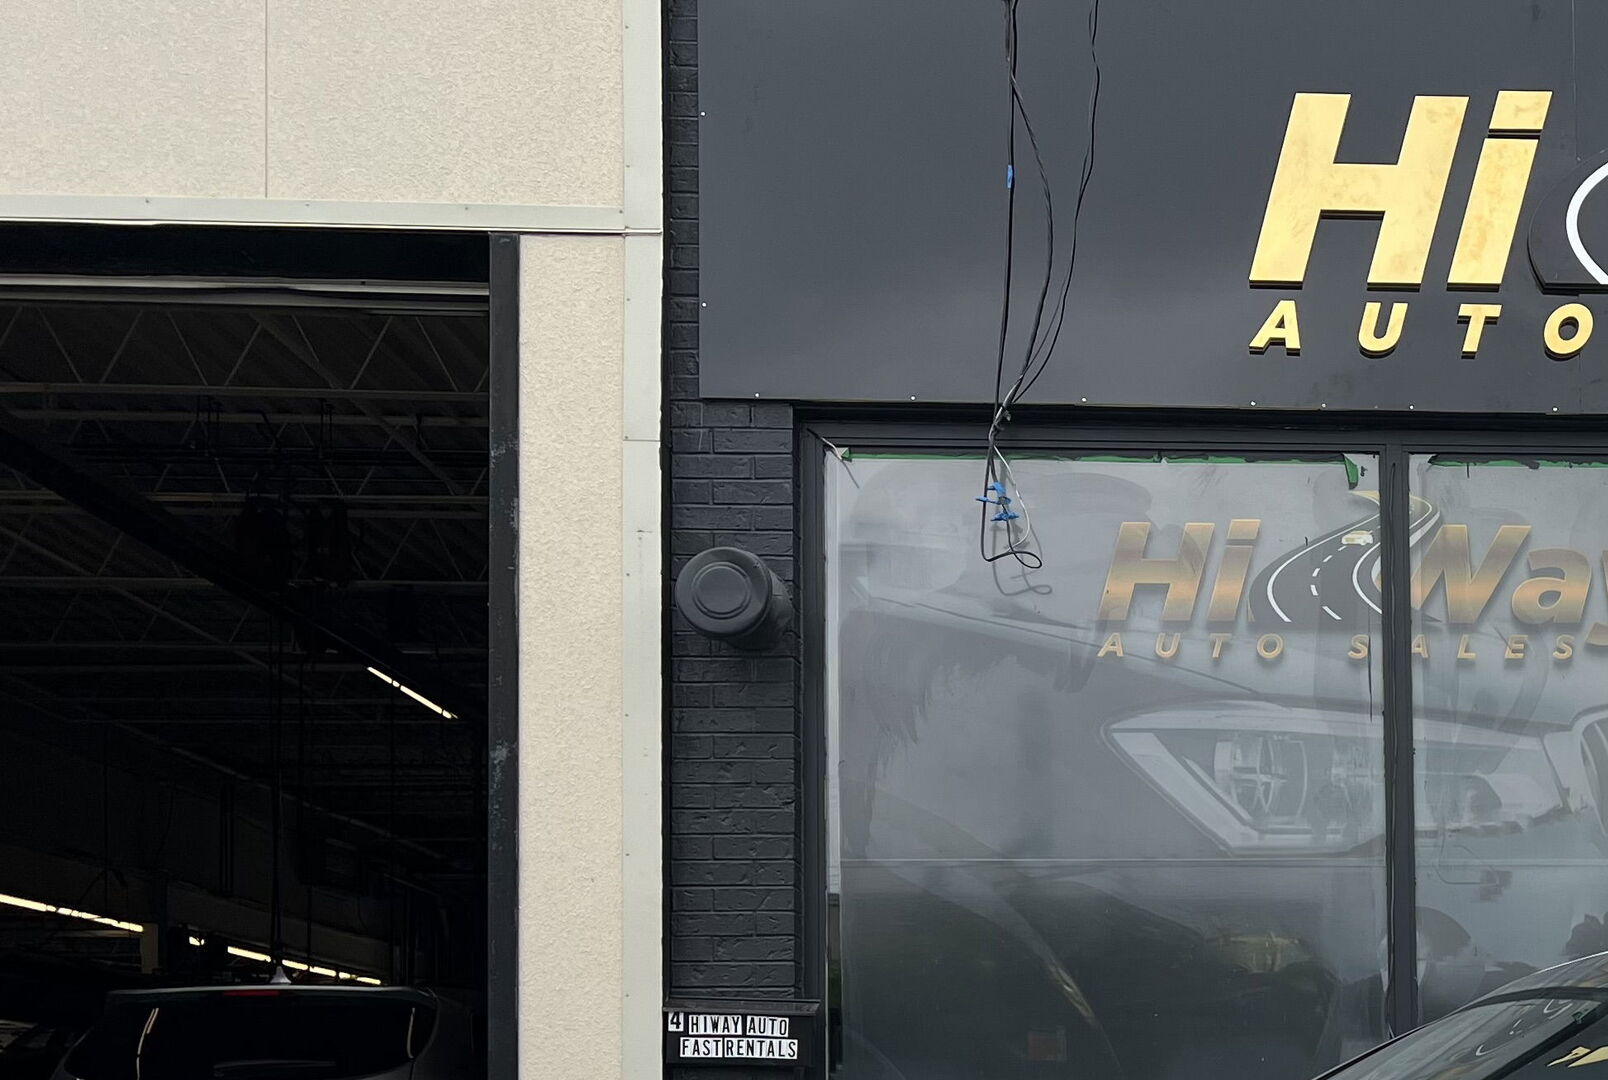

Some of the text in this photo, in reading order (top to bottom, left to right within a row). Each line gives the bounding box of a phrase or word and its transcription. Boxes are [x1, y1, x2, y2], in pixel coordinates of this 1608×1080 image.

[1248, 90, 1552, 286] Hi
[1249, 299, 1595, 357] AUTO
[1097, 519, 1261, 621] Hi
[1097, 632, 1575, 660] AUTO SALES
[670, 1012, 788, 1035] 4 HIWAY AUTO
[682, 1038, 797, 1057] FAST RENTALS
